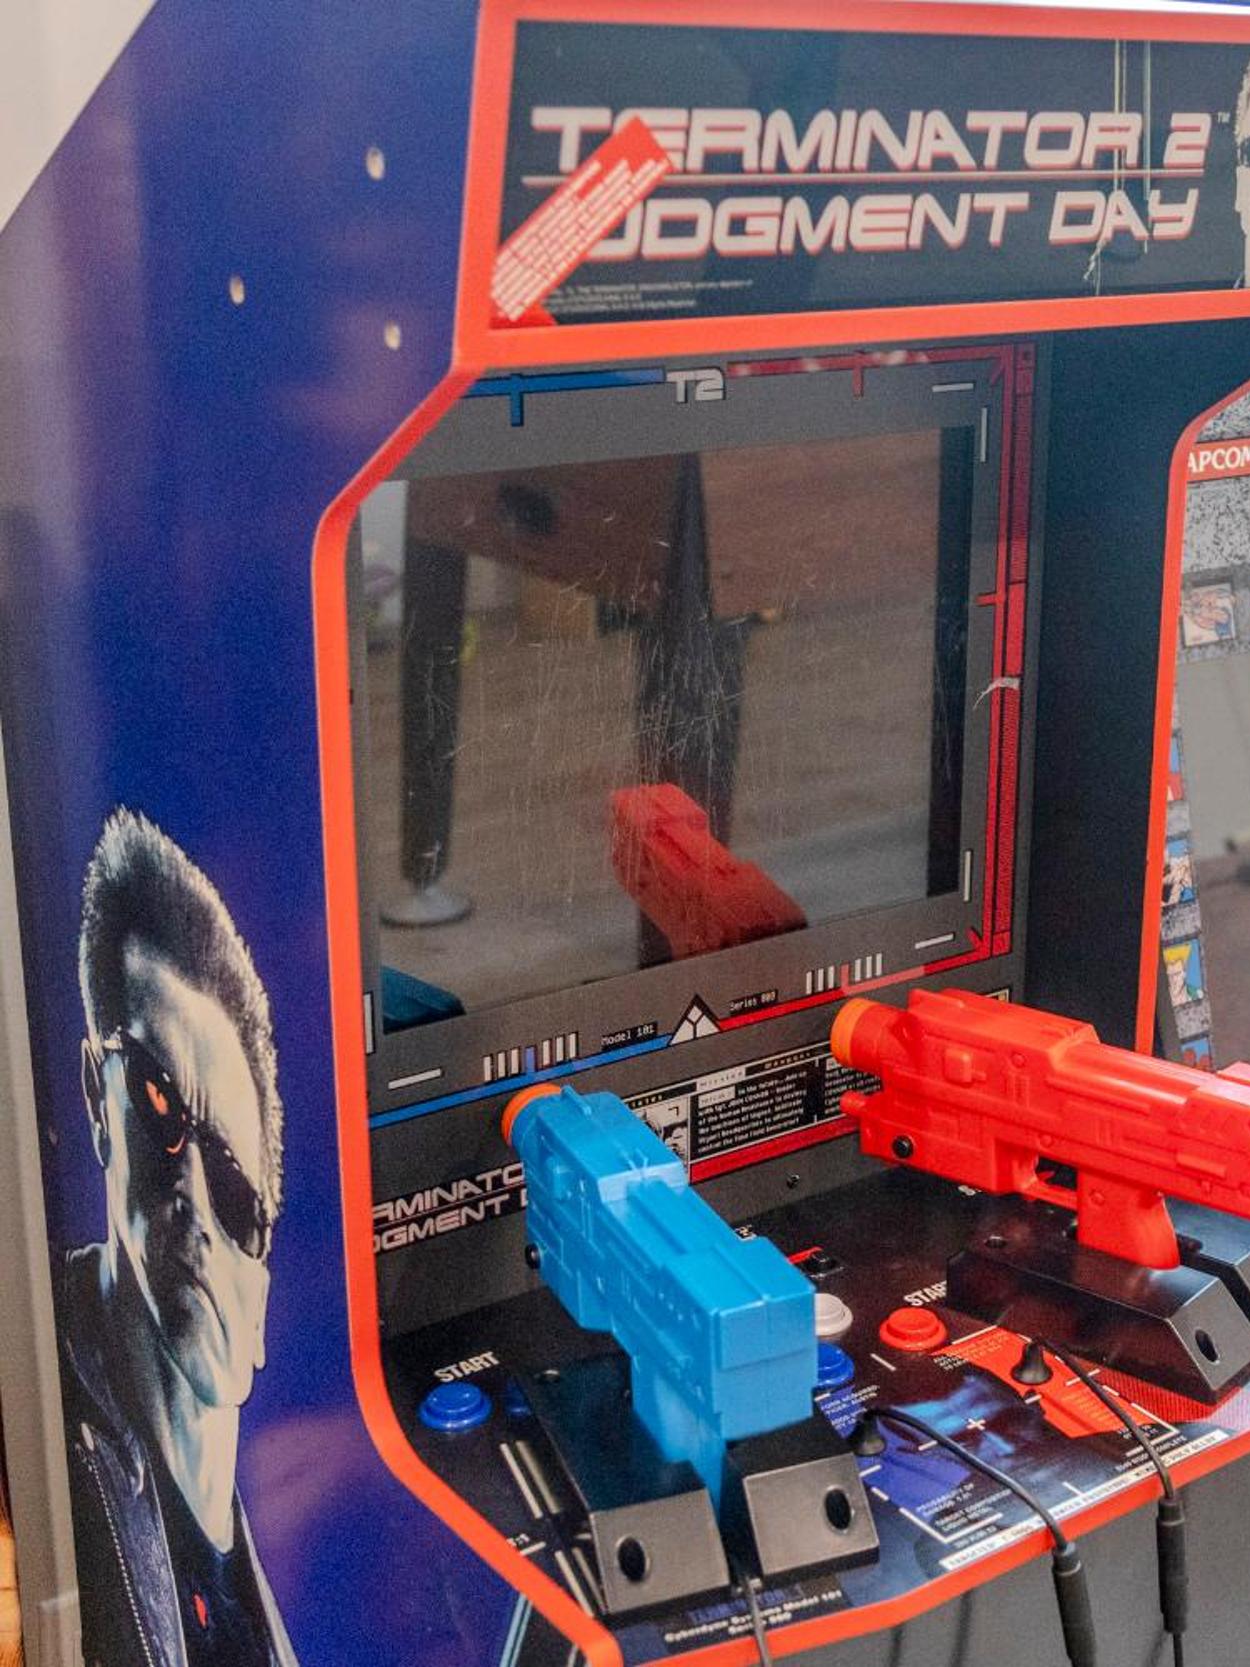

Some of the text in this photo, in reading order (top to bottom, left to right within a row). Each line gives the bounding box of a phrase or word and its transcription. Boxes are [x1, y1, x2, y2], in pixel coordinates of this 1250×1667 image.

[1164, 112, 1211, 170] 2
[1048, 188, 1198, 244] DAY
[666, 368, 724, 402] T2
[601, 1029, 631, 1046] Model
[434, 1351, 499, 1382] START
[783, 1595, 819, 1612] Model
